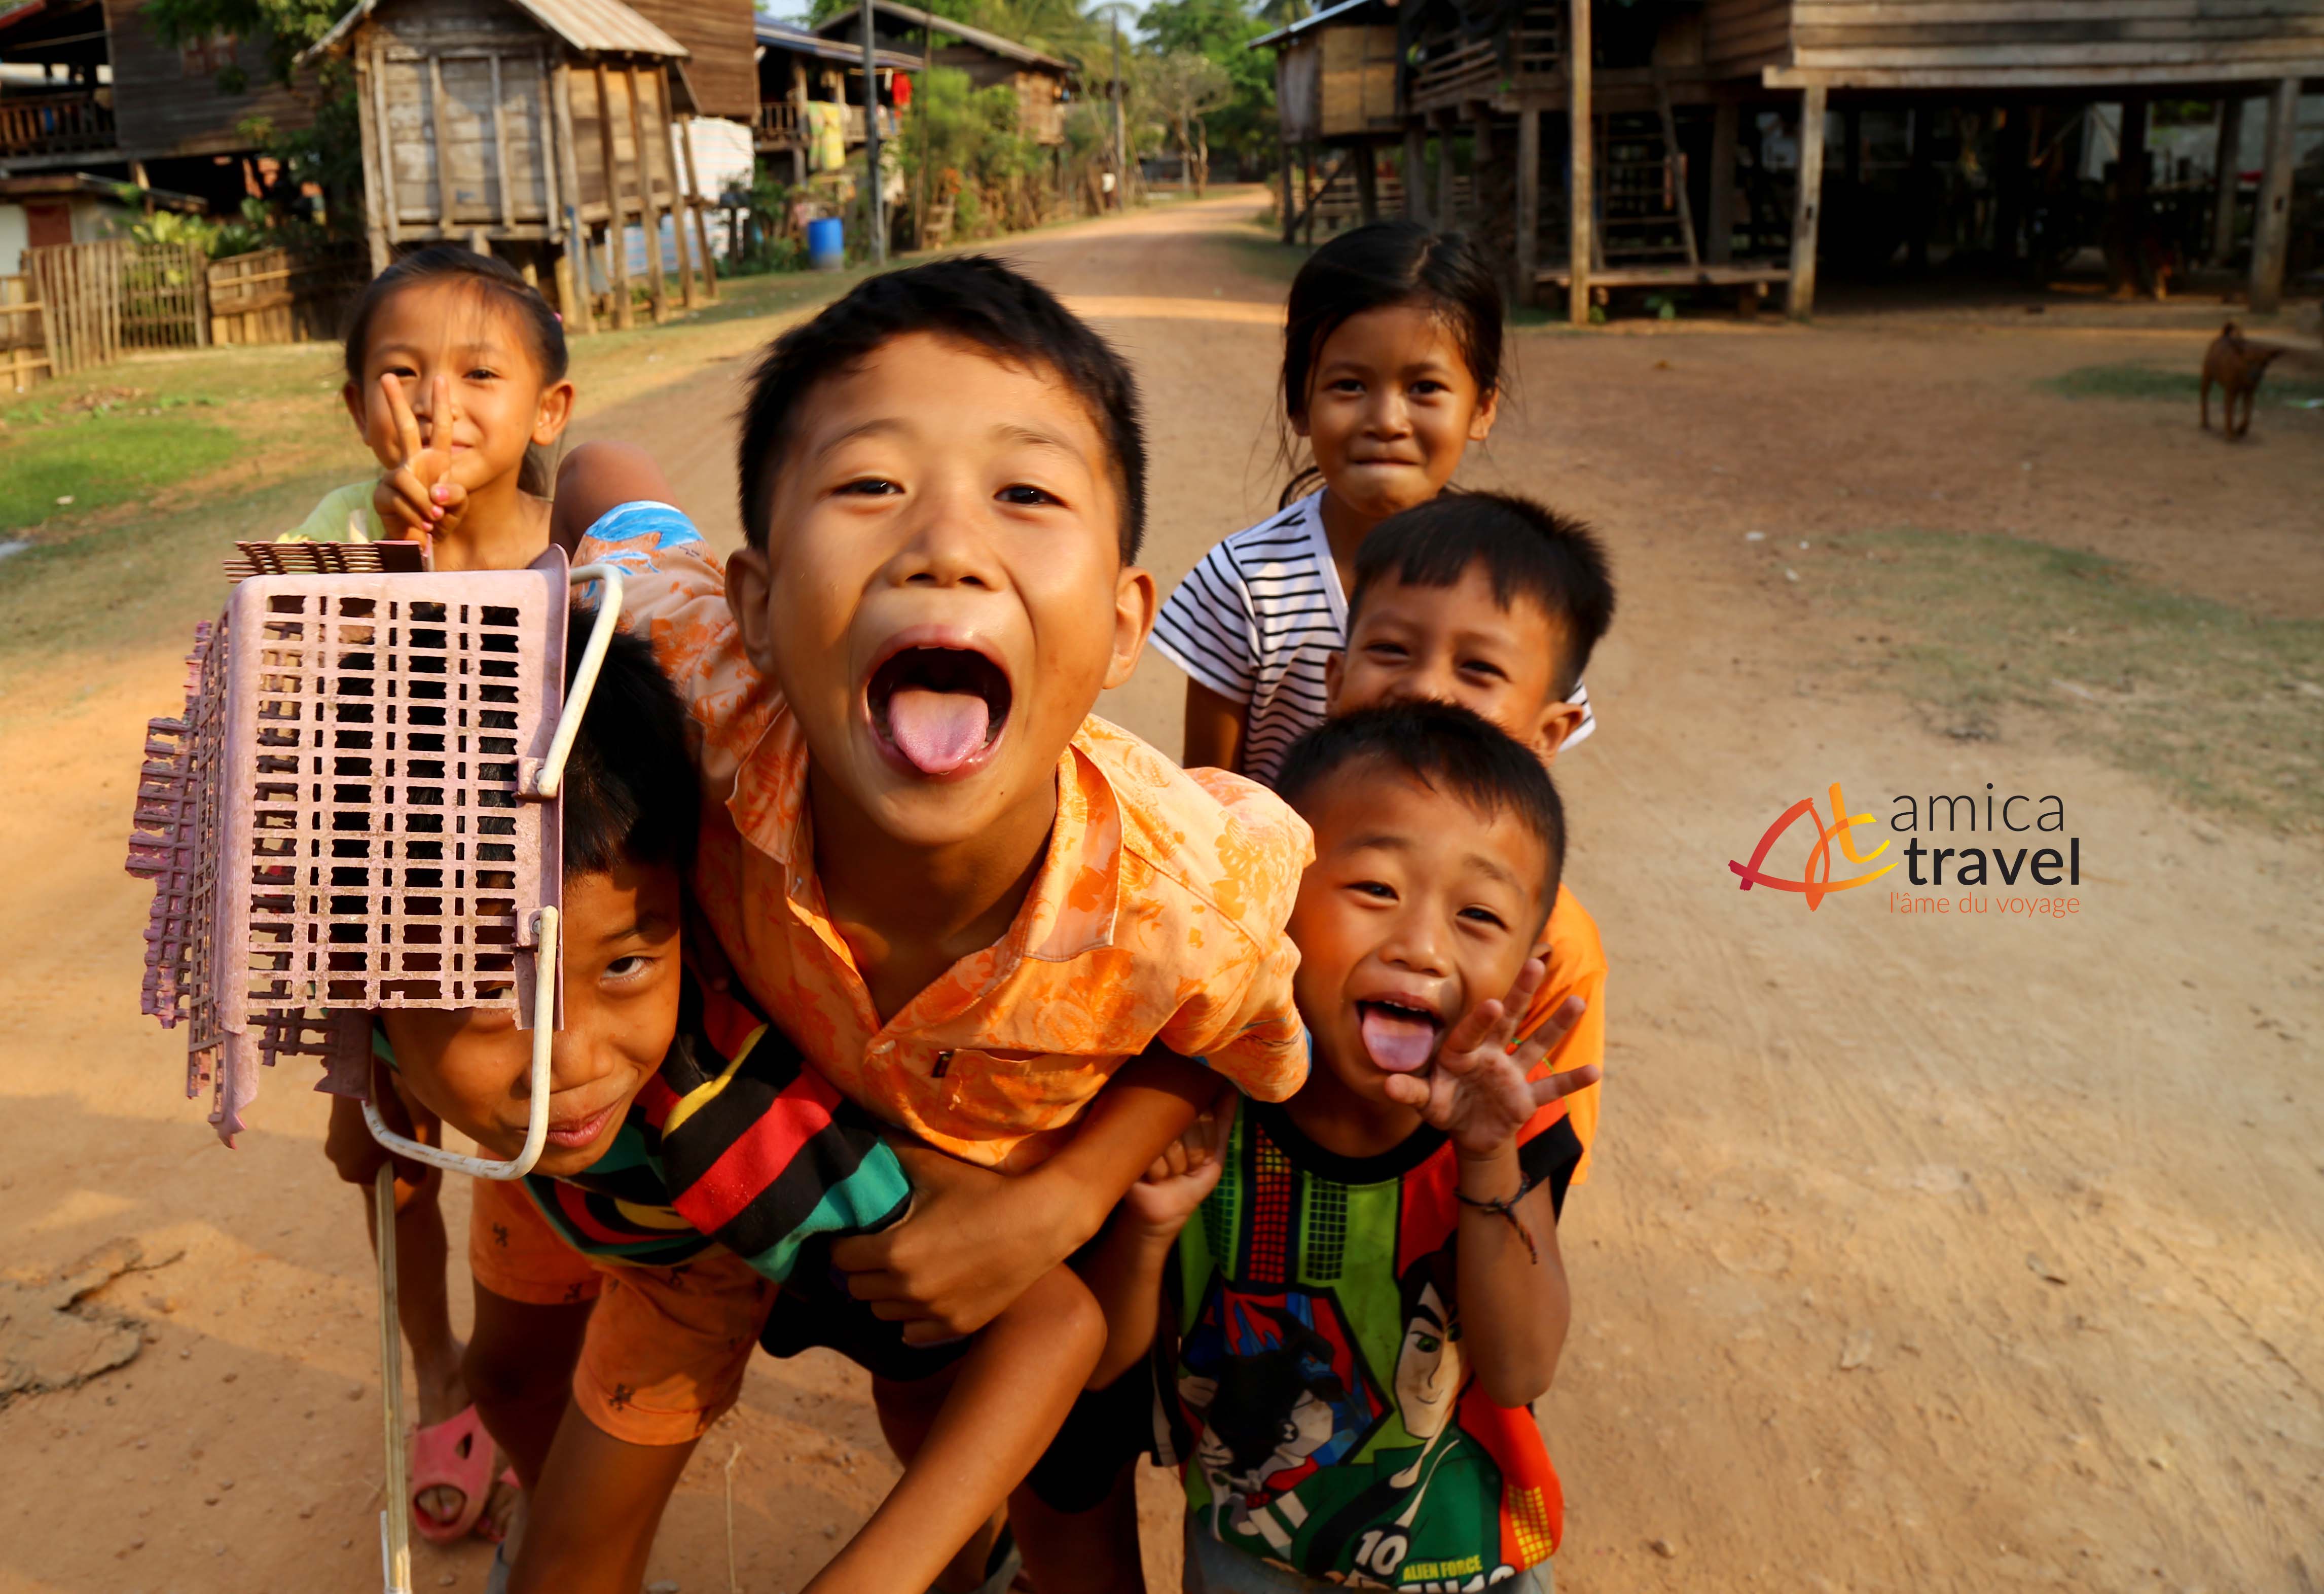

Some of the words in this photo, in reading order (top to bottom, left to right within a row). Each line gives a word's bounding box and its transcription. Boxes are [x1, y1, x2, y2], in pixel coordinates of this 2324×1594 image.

[1355, 1529, 1408, 1576] 10
[1402, 1562, 1439, 1581] ALIEN
[1440, 1554, 1483, 1578] FORCE
